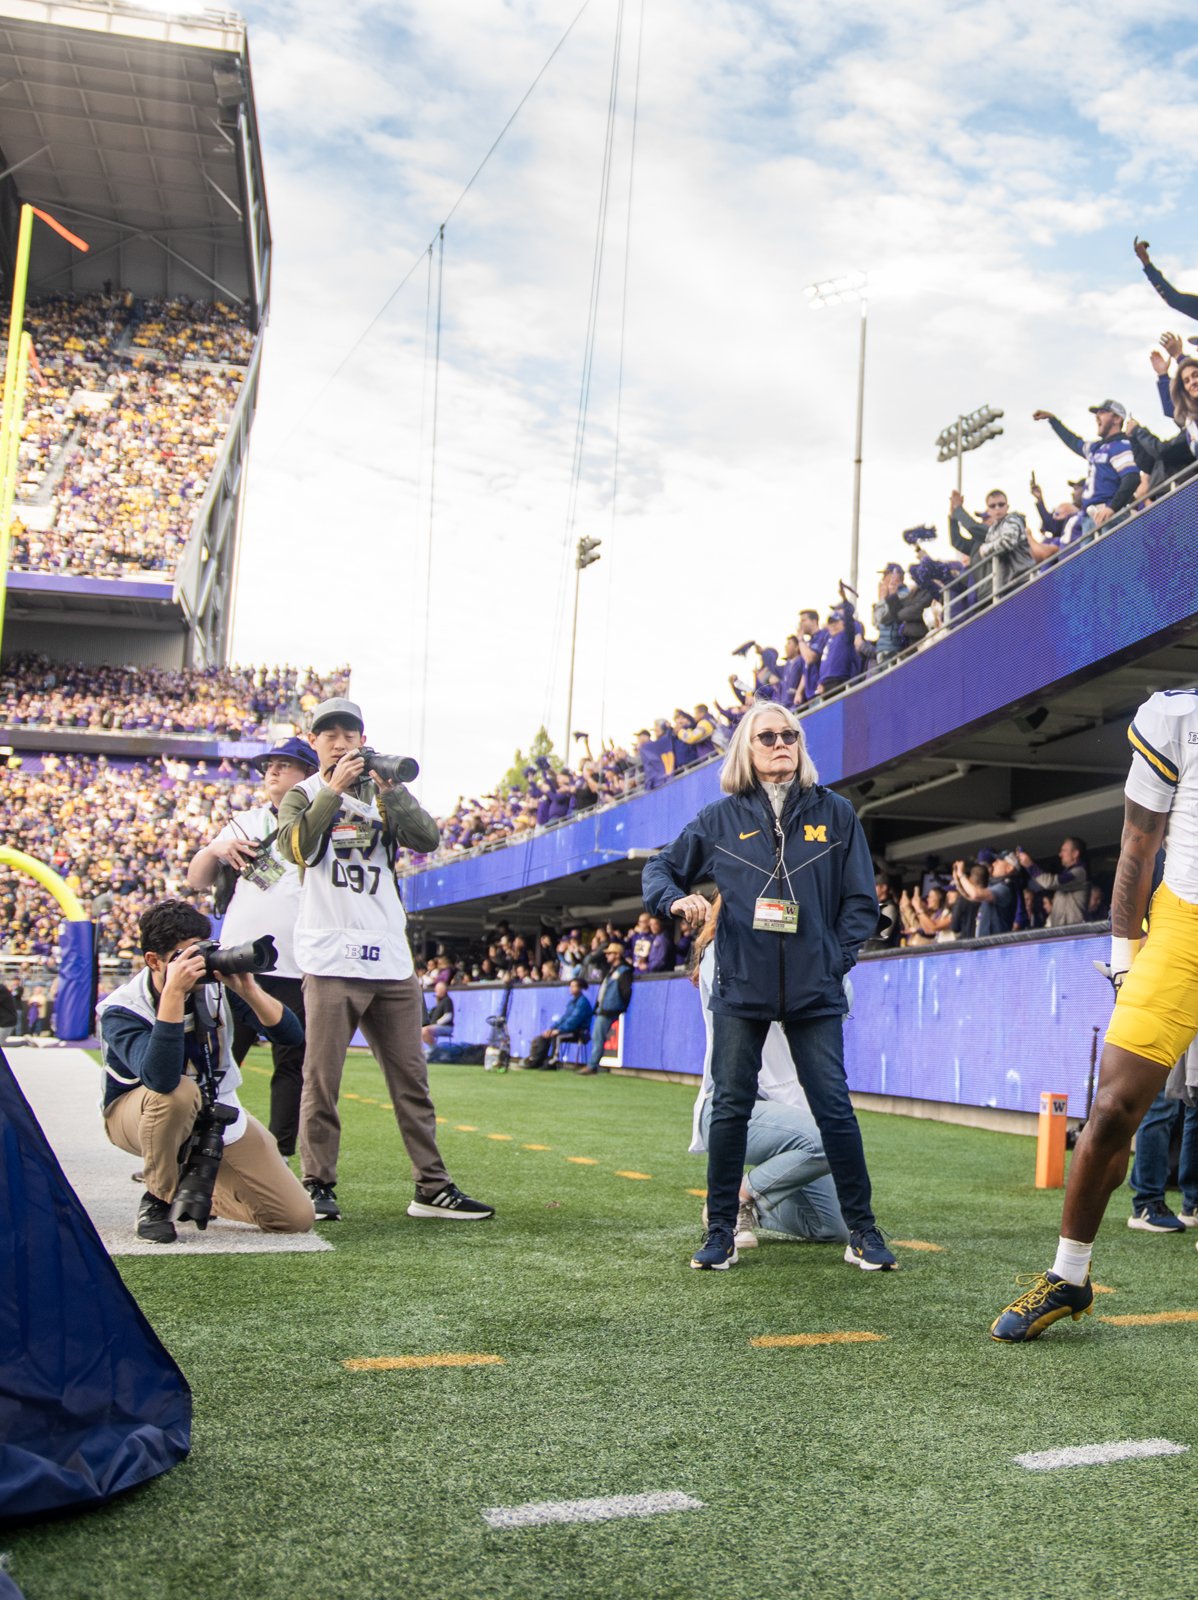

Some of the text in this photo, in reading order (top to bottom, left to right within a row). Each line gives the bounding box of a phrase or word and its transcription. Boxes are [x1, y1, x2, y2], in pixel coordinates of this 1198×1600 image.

[804, 825, 828, 842] M
[332, 858, 381, 895] 097
[1053, 1101, 1065, 1112] W
